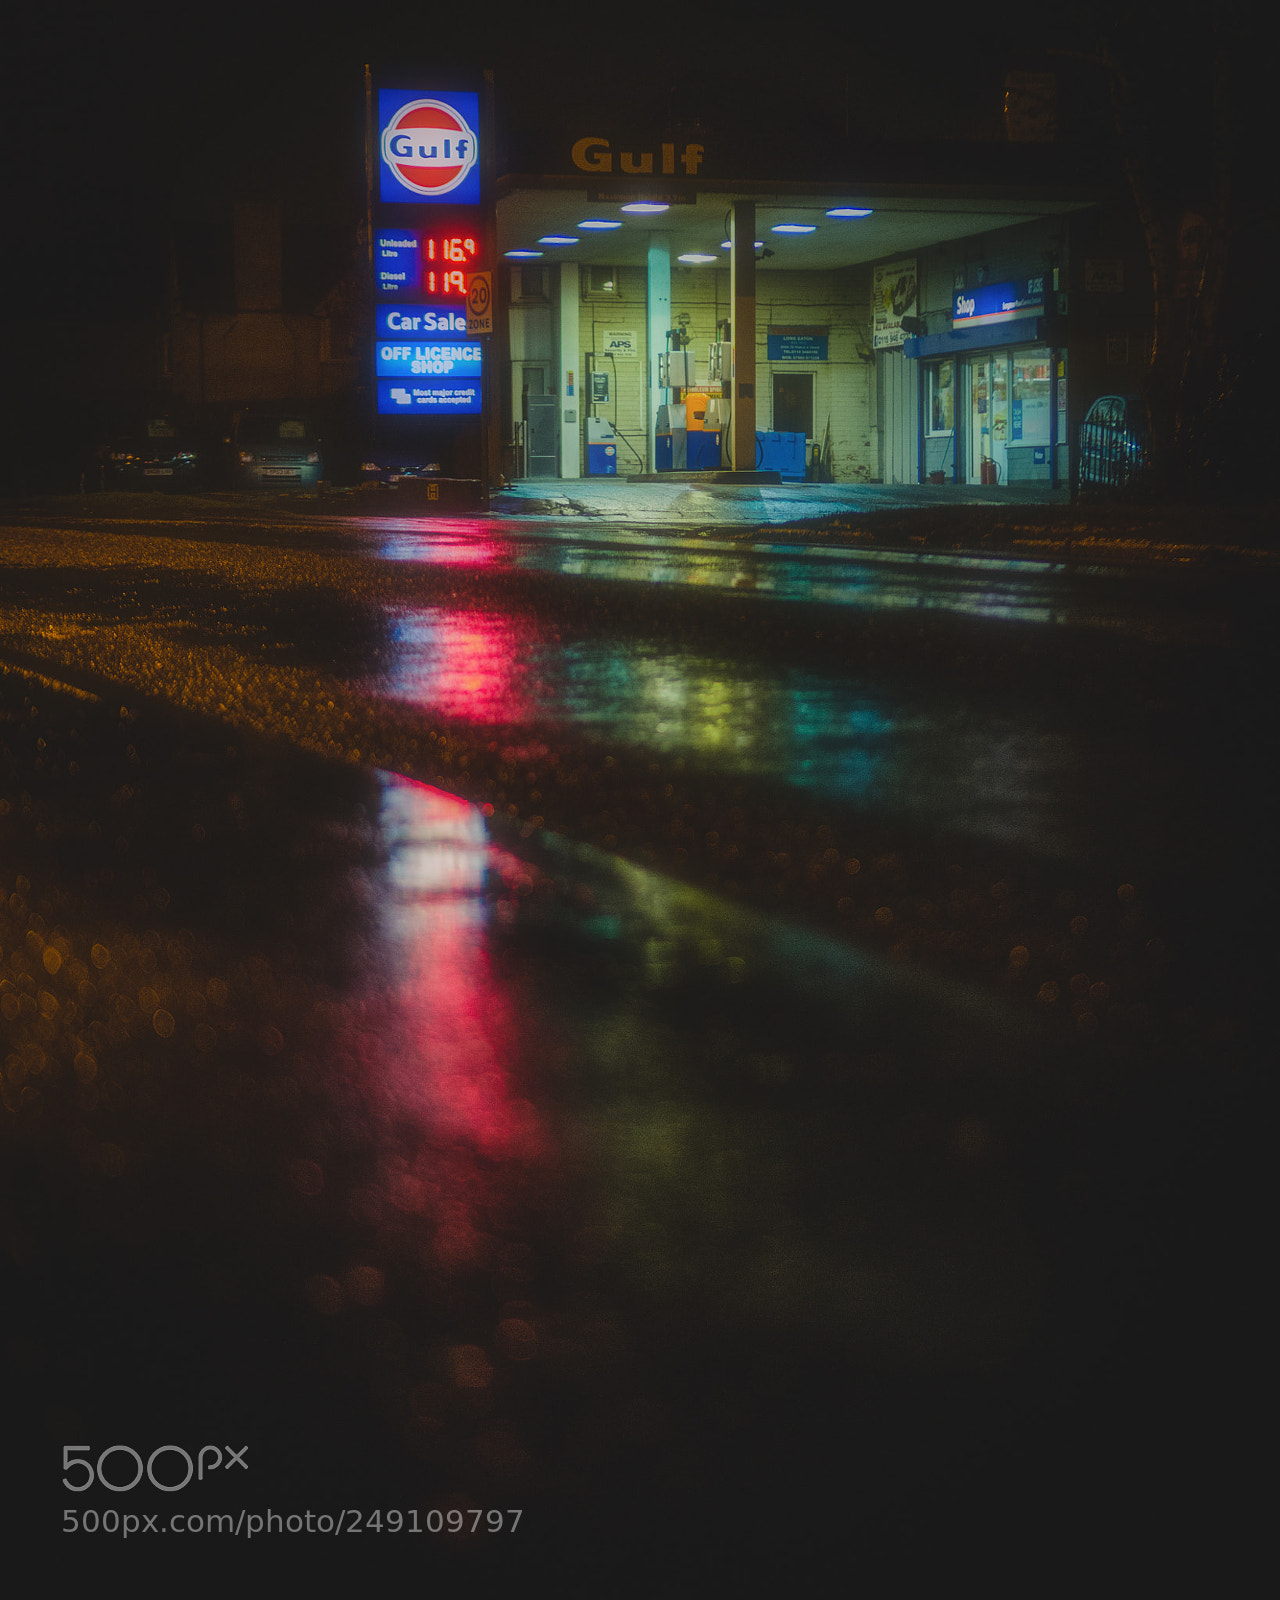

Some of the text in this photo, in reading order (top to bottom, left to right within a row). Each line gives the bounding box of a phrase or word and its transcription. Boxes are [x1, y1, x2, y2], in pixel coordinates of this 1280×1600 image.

[389, 134, 469, 159] Gulf
[571, 136, 705, 175] Gulf
[380, 239, 417, 248] Unleaded
[380, 271, 406, 280] Diesel
[471, 287, 488, 304] 20
[956, 296, 975, 316] Shop
[387, 312, 421, 330] Car
[468, 318, 490, 329] ZONE
[610, 340, 631, 348] APS
[381, 347, 482, 361] OFF LICENCE
[411, 360, 454, 374] SHOP
[432, 389, 453, 397] major
[438, 396, 472, 404] accepted
